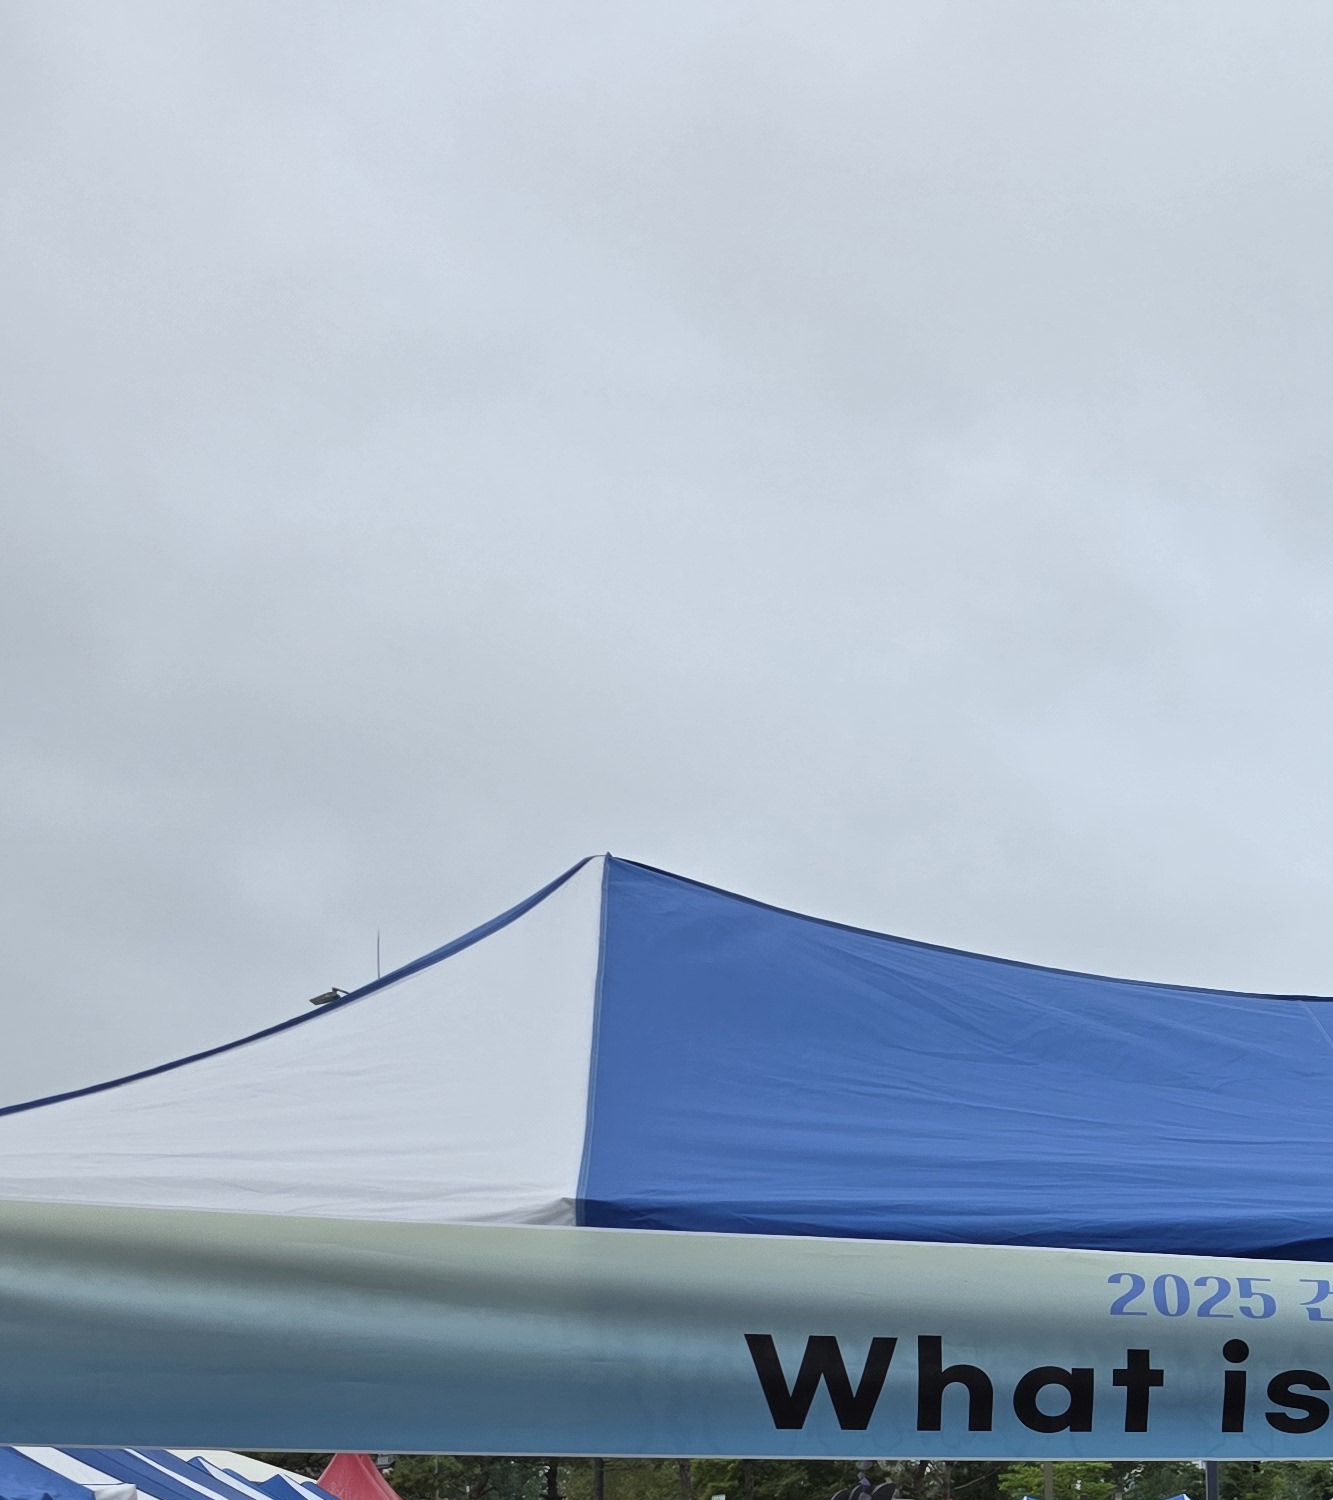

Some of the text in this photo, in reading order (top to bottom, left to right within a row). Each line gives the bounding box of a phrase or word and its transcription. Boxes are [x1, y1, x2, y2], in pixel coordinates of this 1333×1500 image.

[1107, 1273, 1277, 1320] 2025
[744, 1333, 1165, 1433] What
[1220, 1338, 1331, 1434] is
